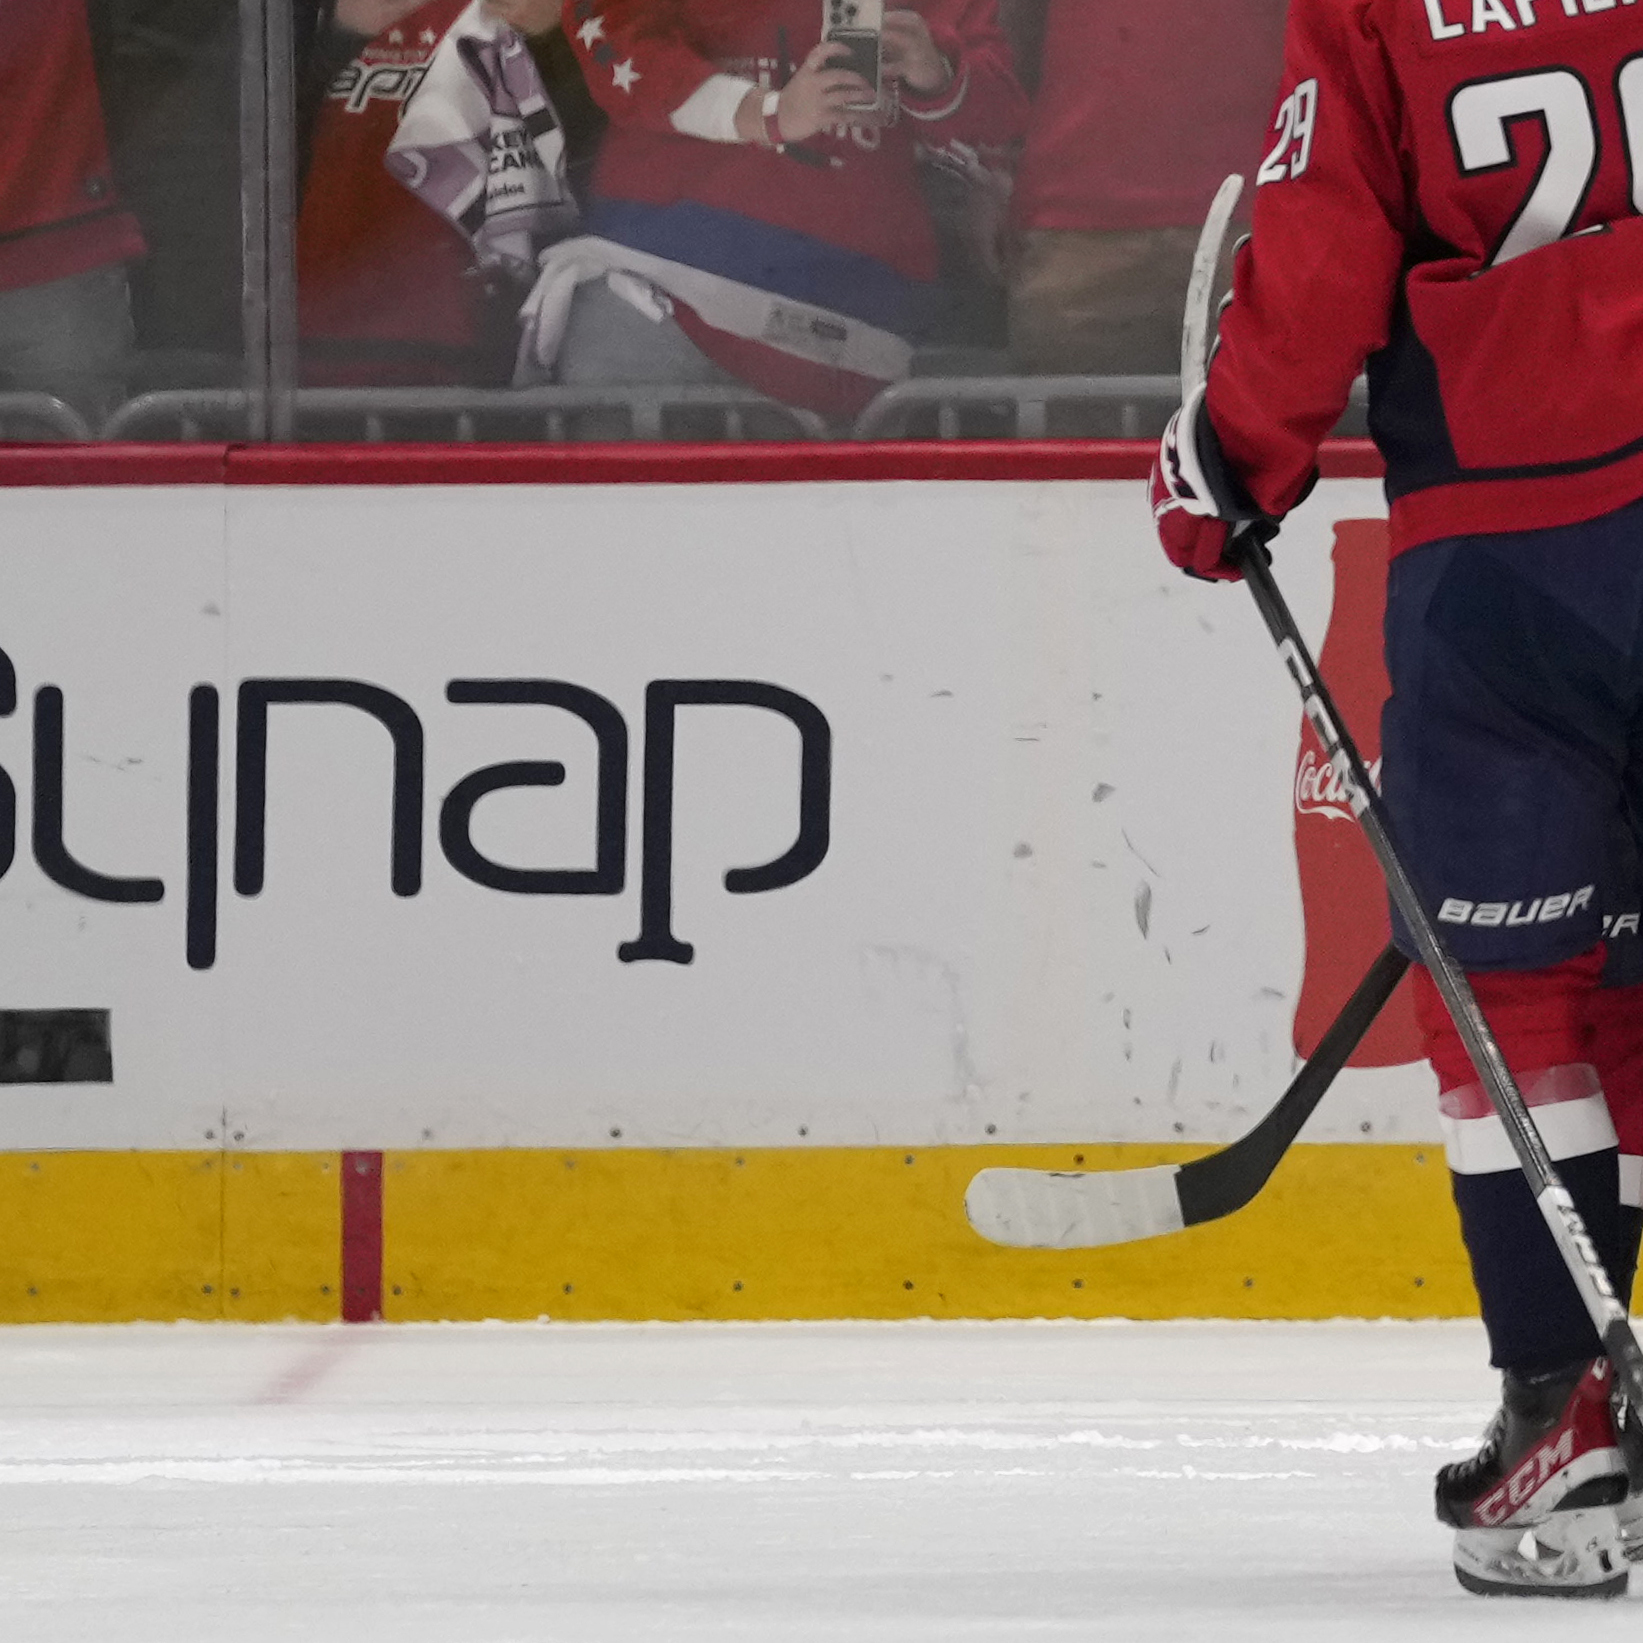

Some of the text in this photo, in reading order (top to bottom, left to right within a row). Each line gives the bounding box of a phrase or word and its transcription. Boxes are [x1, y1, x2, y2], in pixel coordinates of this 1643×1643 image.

[1256, 78, 1319, 187] 29
[0, 648, 832, 970] ynap
[1437, 884, 1595, 928] BAUER
[1475, 1428, 1577, 1526] CCM
